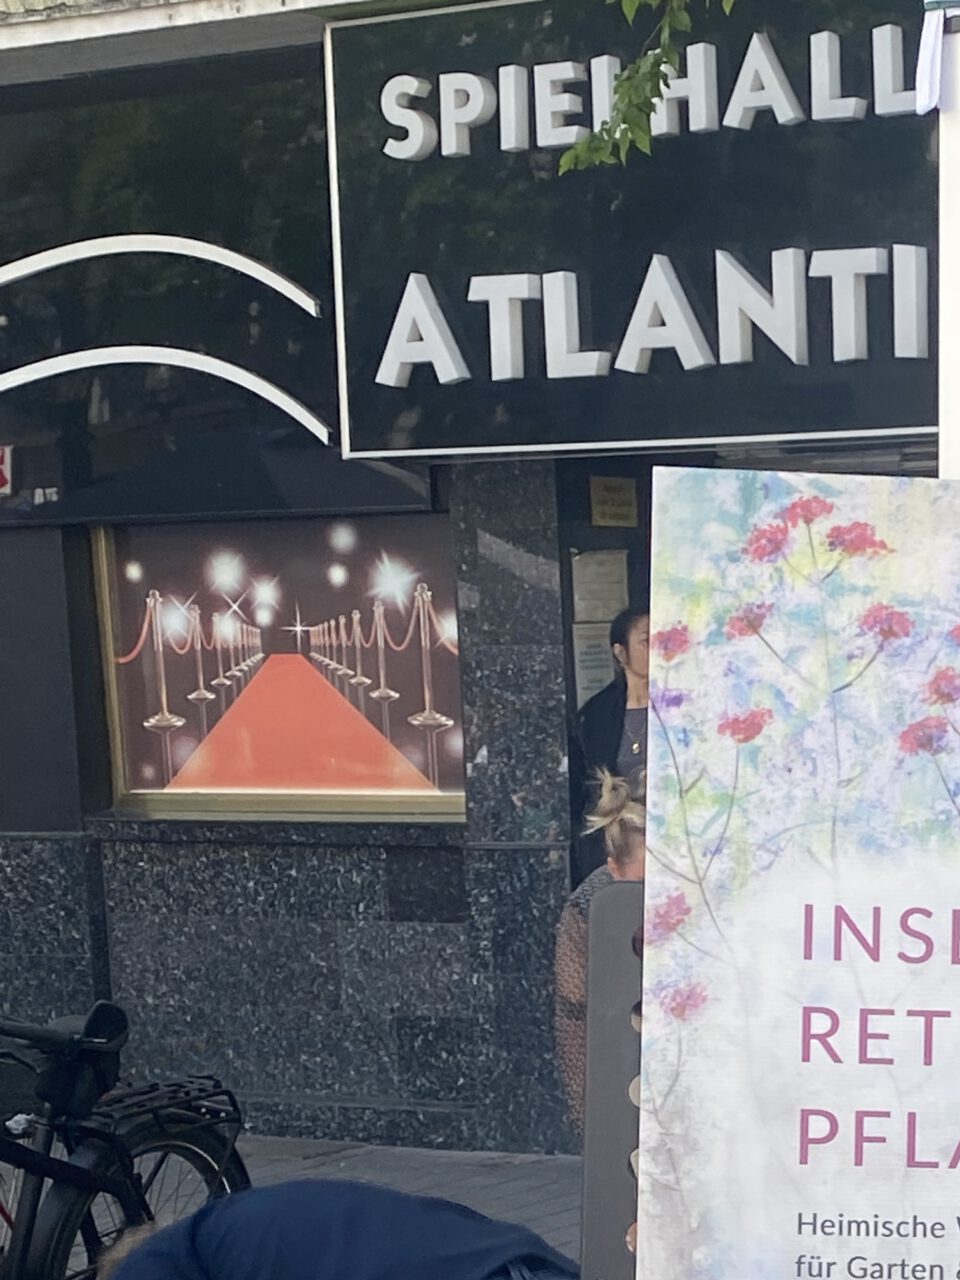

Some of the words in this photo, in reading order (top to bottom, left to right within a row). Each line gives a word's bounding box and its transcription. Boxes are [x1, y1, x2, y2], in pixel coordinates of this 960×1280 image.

[380, 23, 920, 162] SPIELHALL
[797, 1213, 947, 1239] Heimische
[795, 1254, 837, 1279] für
[847, 1256, 945, 1280] Garten
